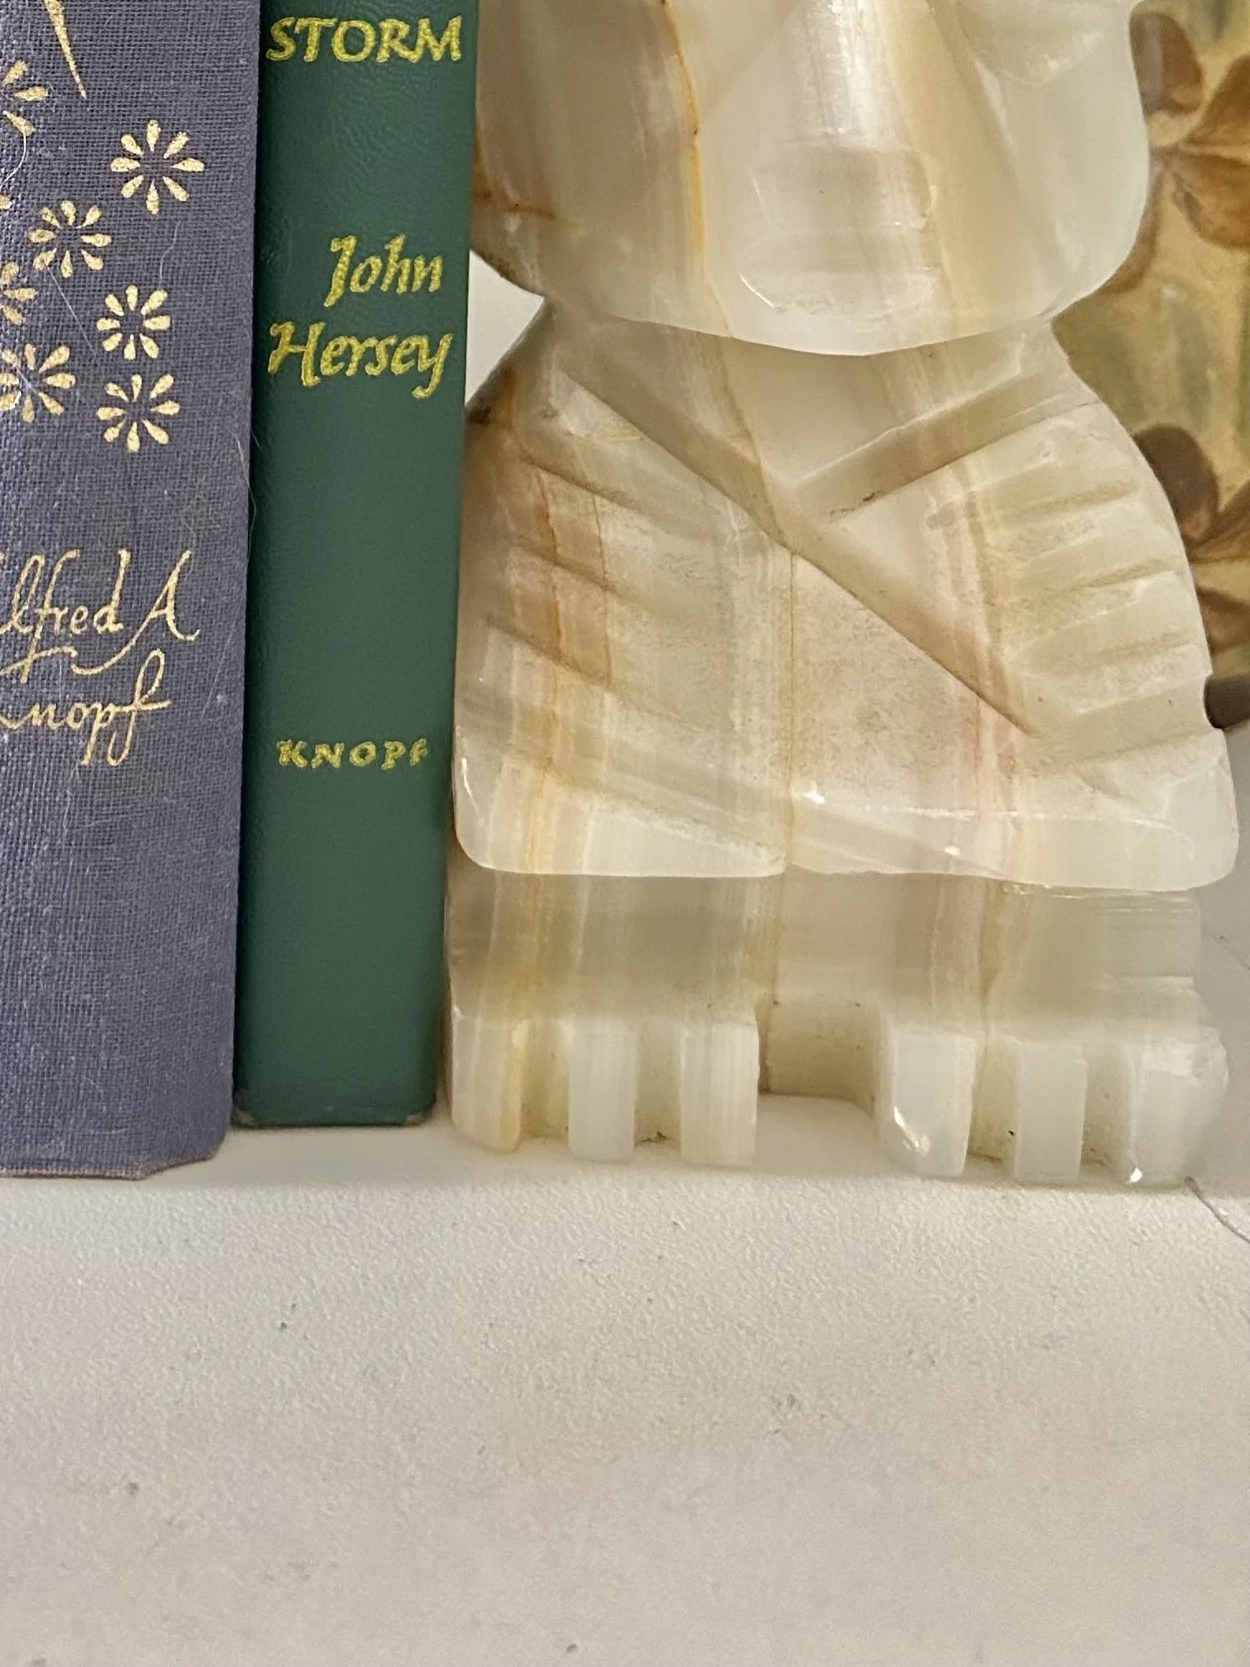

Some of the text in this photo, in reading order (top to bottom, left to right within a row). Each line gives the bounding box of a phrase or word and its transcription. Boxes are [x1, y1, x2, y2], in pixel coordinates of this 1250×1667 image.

[266, 15, 462, 63] STORM
[324, 234, 443, 307] John
[267, 321, 452, 399] Hersey
[71, 549, 200, 674] A
